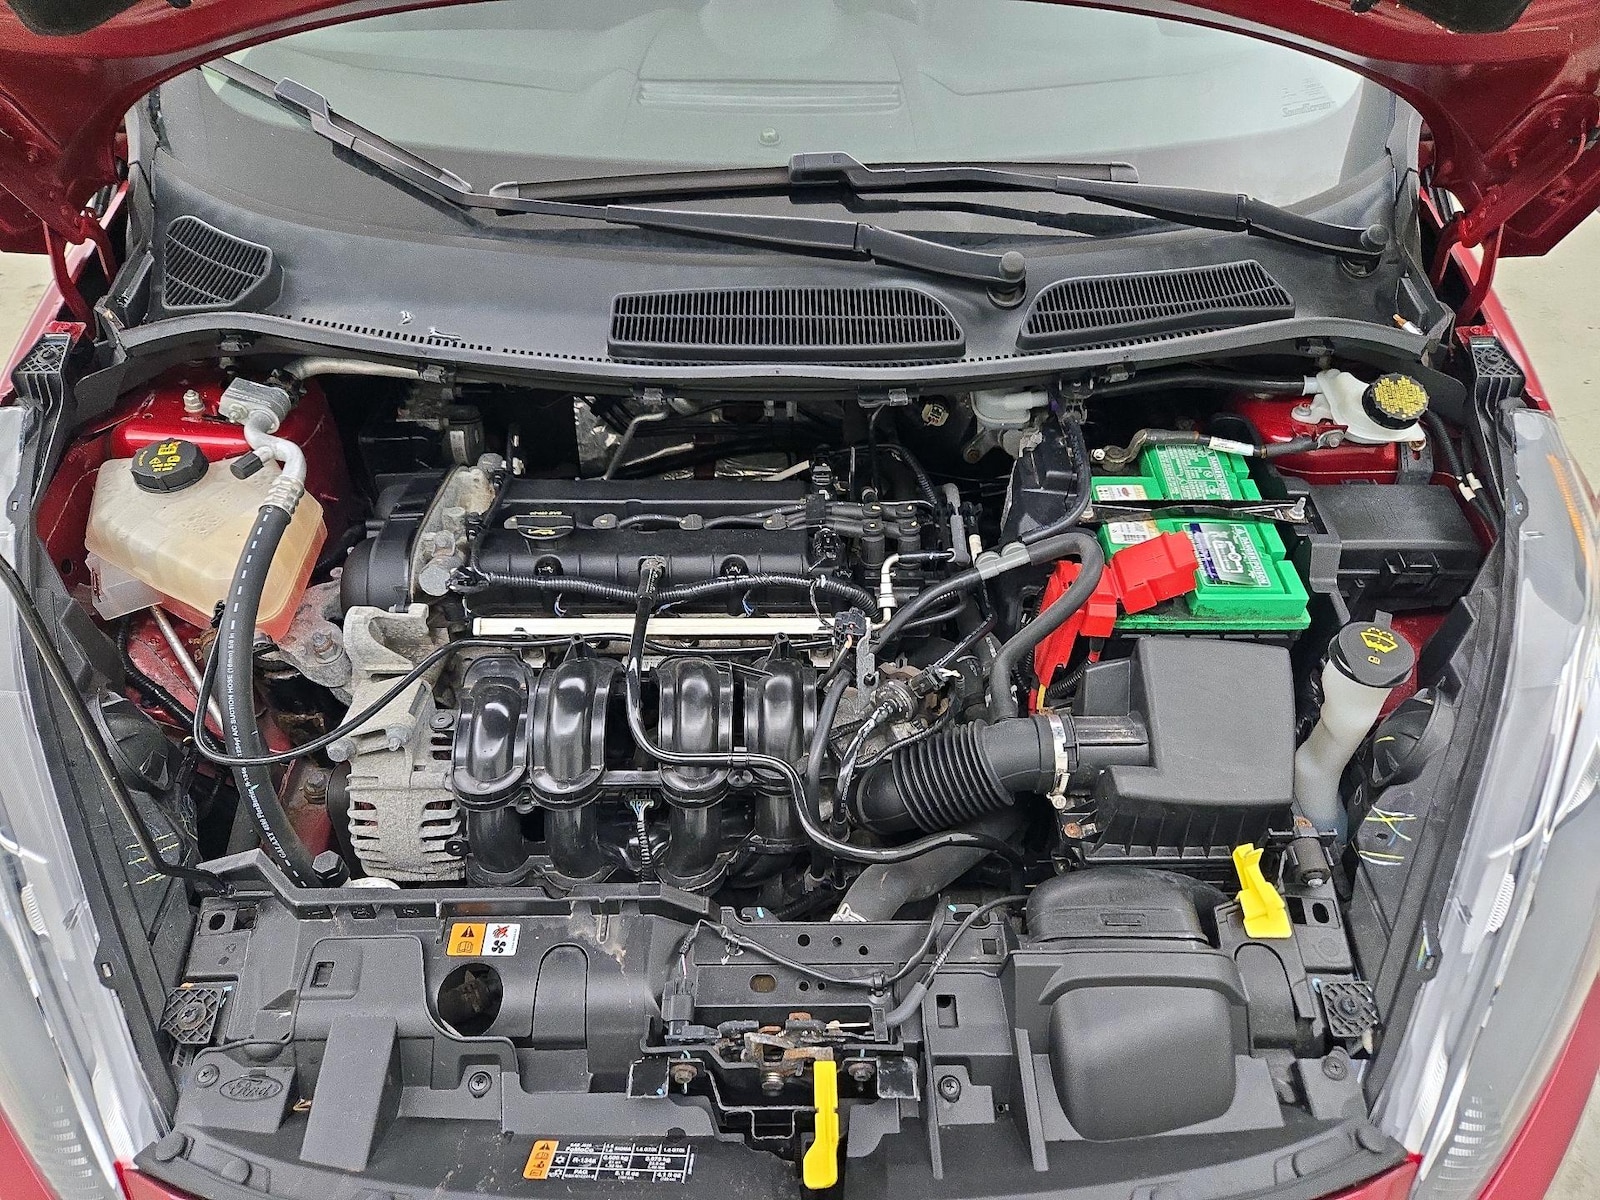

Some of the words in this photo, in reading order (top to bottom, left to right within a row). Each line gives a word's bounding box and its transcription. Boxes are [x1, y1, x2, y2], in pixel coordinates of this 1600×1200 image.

[226, 674, 235, 694] HOSE
[227, 694, 238, 726] SUCTION
[231, 725, 239, 738] A/C
[266, 832, 287, 859] GALAXY
[228, 1077, 273, 1097] Ford
